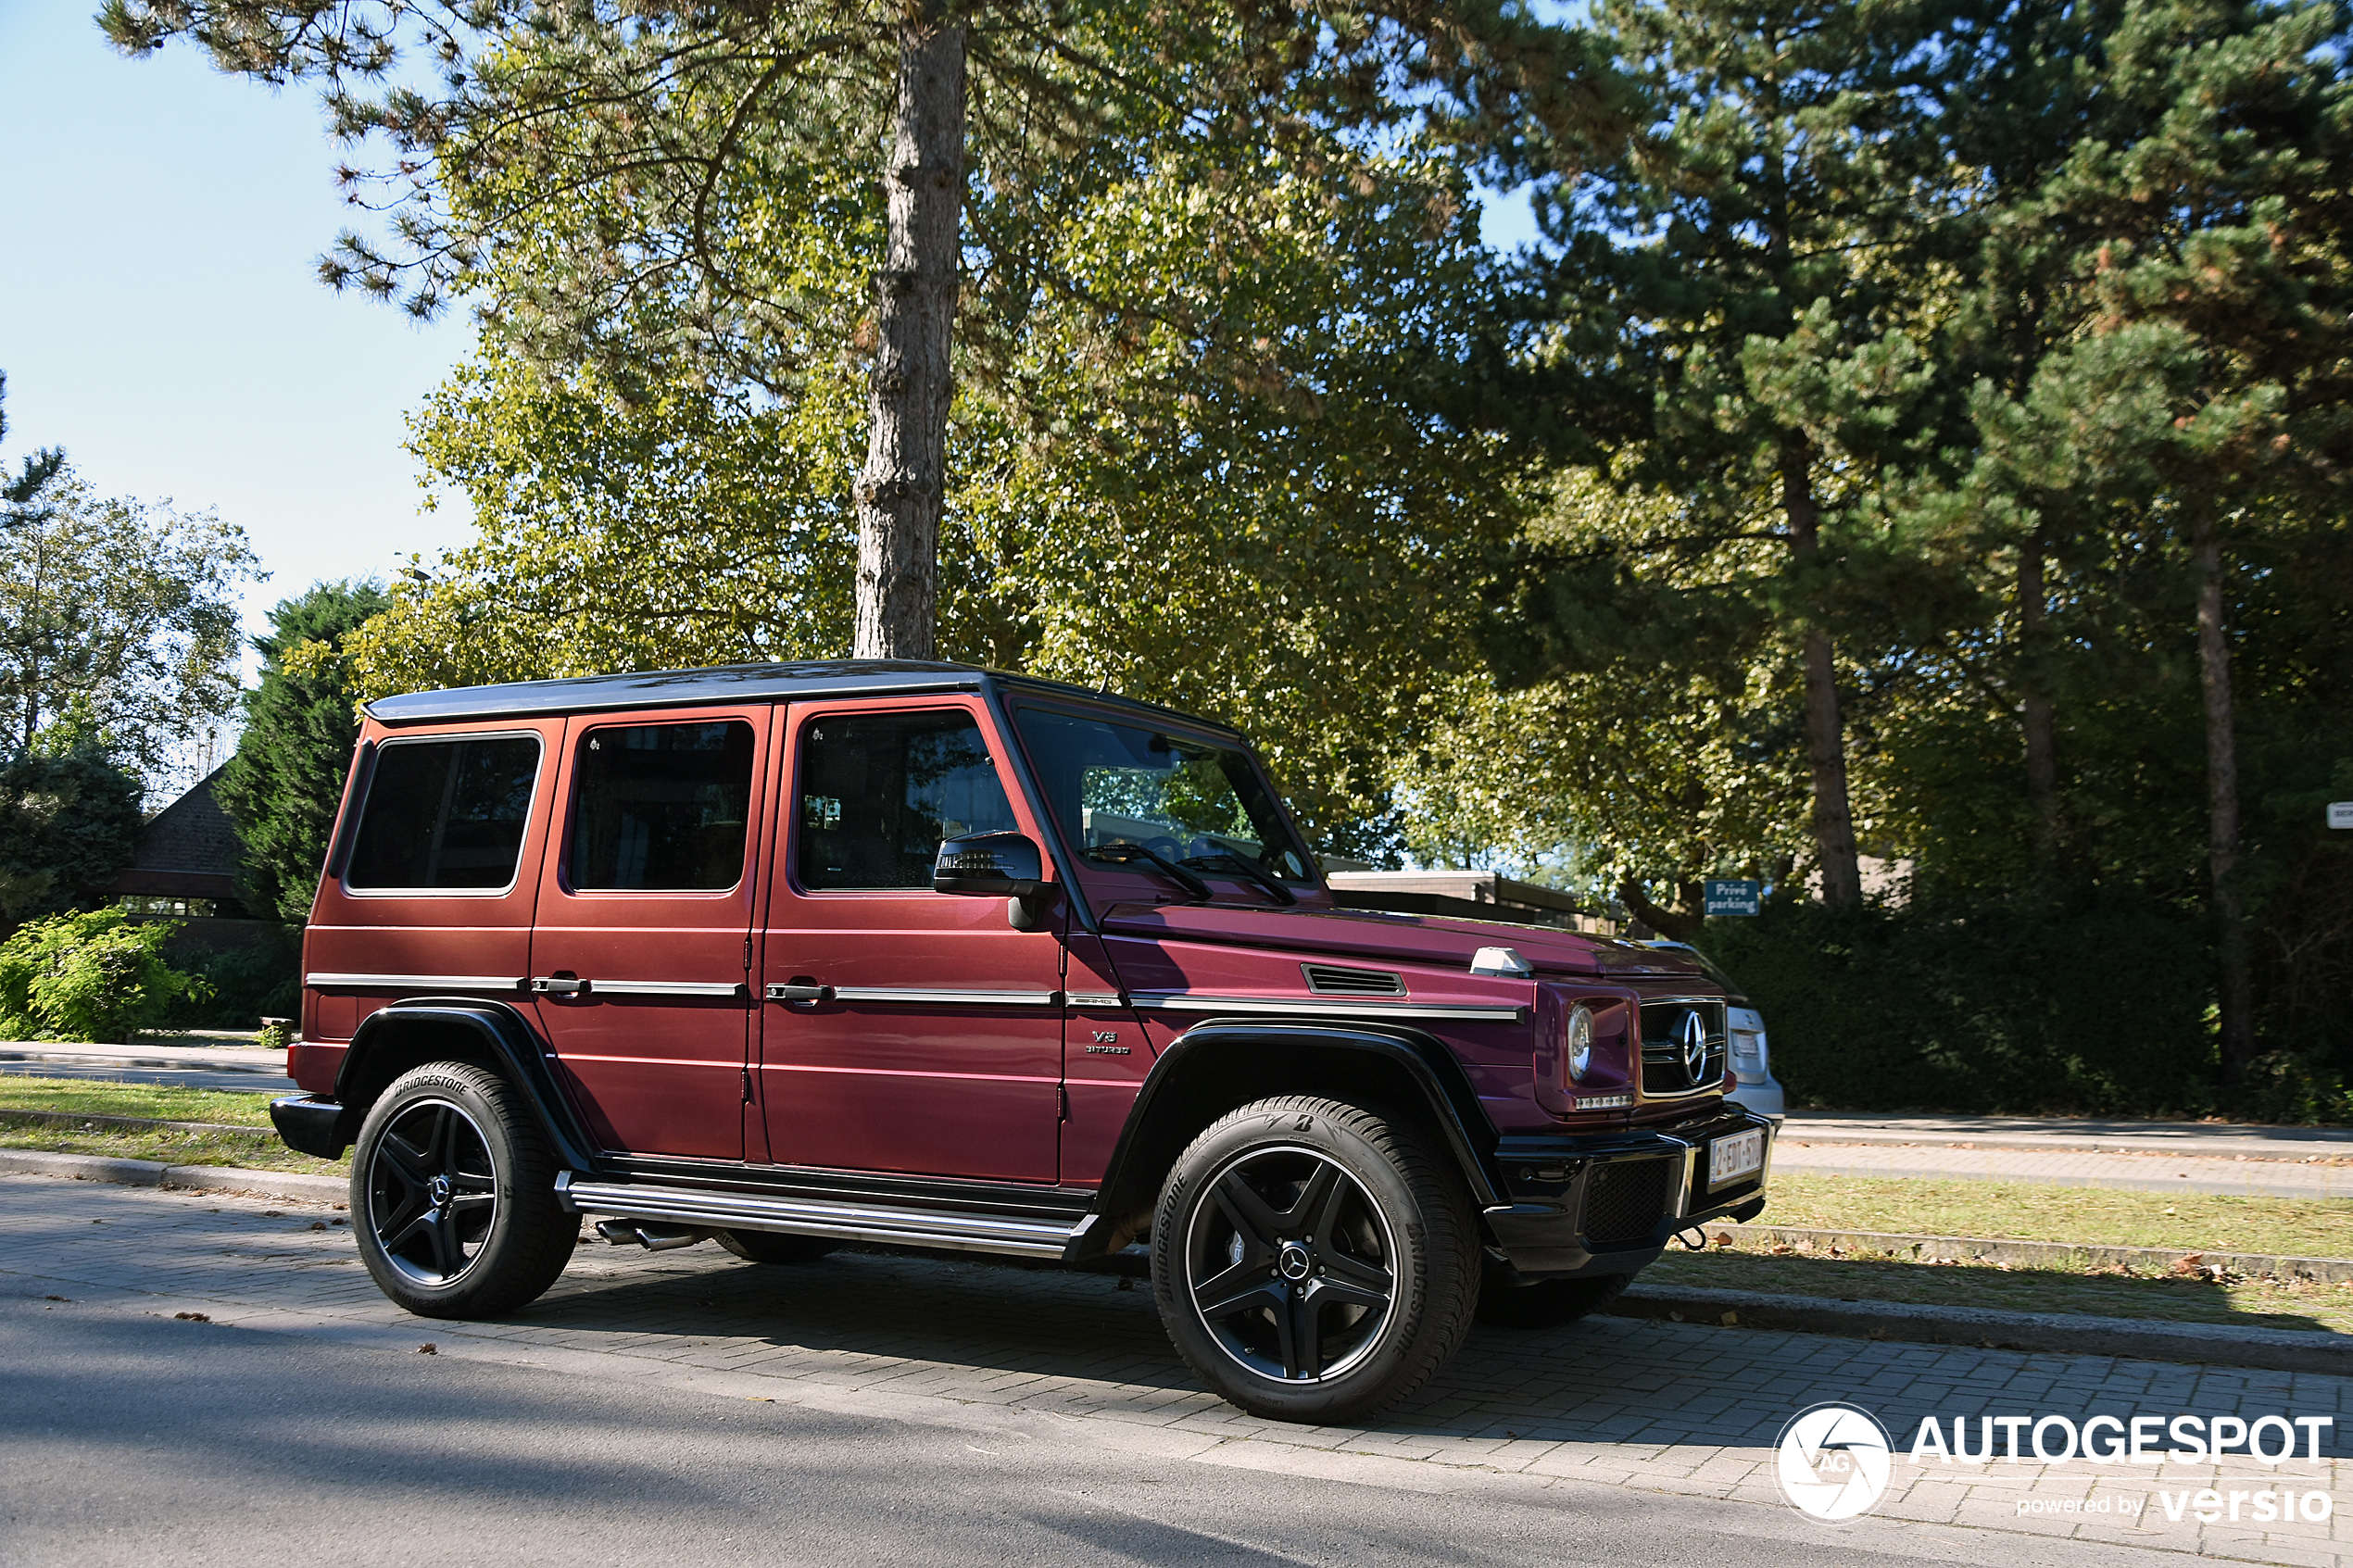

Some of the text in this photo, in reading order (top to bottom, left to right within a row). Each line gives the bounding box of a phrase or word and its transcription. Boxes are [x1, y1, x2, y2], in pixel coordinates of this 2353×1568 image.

[1716, 883, 1748, 896] Privé
[1708, 897, 1756, 914] parking
[1092, 1030, 1118, 1043] V8
[1086, 1045, 1131, 1055] BITURBO
[395, 1074, 470, 1099] BRIDGESTONE
[1156, 1172, 1188, 1304] BRIDGESTONE
[1393, 1223, 1428, 1361] BRIDGESTONE
